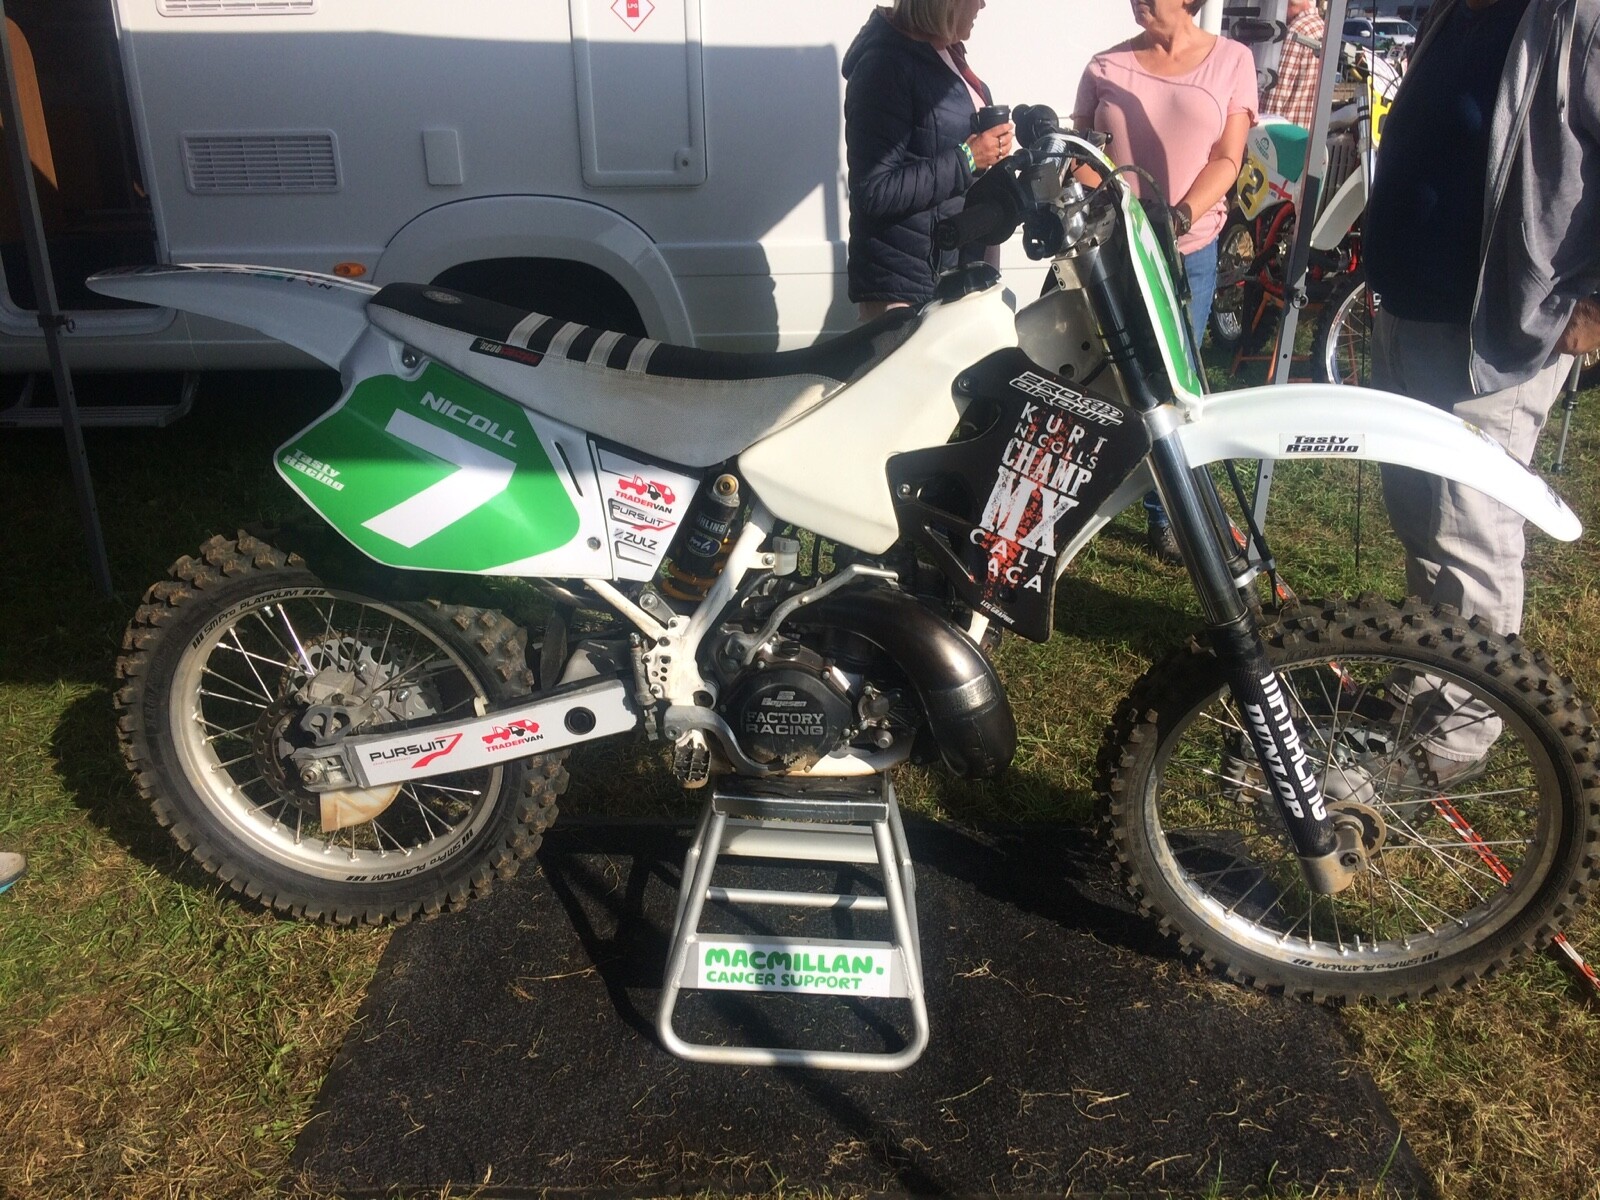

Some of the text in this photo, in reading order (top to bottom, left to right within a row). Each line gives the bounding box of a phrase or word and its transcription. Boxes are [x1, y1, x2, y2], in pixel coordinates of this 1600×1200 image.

[1019, 371, 1083, 398] PRO
[1009, 378, 1123, 426] CIRCUIT
[420, 391, 517, 448] NICOLL
[1020, 401, 1108, 453] KURT
[1285, 444, 1359, 453] Racing
[1294, 435, 1349, 444] Tasty
[282, 455, 345, 491] Racing
[294, 449, 341, 478] Tasty
[1002, 437, 1093, 497] CHAMP
[361, 408, 517, 548] 7
[612, 504, 664, 527] PURSUIT
[615, 490, 673, 515] TRADERVAN
[979, 465, 1080, 557] MX
[624, 531, 658, 551] ZULZ
[218, 609, 236, 624] Pro
[240, 590, 299, 611] PLATINUM
[745, 723, 824, 736] RACING
[746, 711, 824, 725] FACTORY
[369, 739, 447, 762] PURSUIT
[486, 733, 544, 753] TRADERVAN
[1244, 701, 1305, 819] DUNLOP
[371, 863, 426, 881] PLATINUM
[704, 948, 884, 975] MACMILLAN.
[1316, 962, 1375, 972] PLATINUM
[706, 970, 863, 990] CANCER SUPPORT
